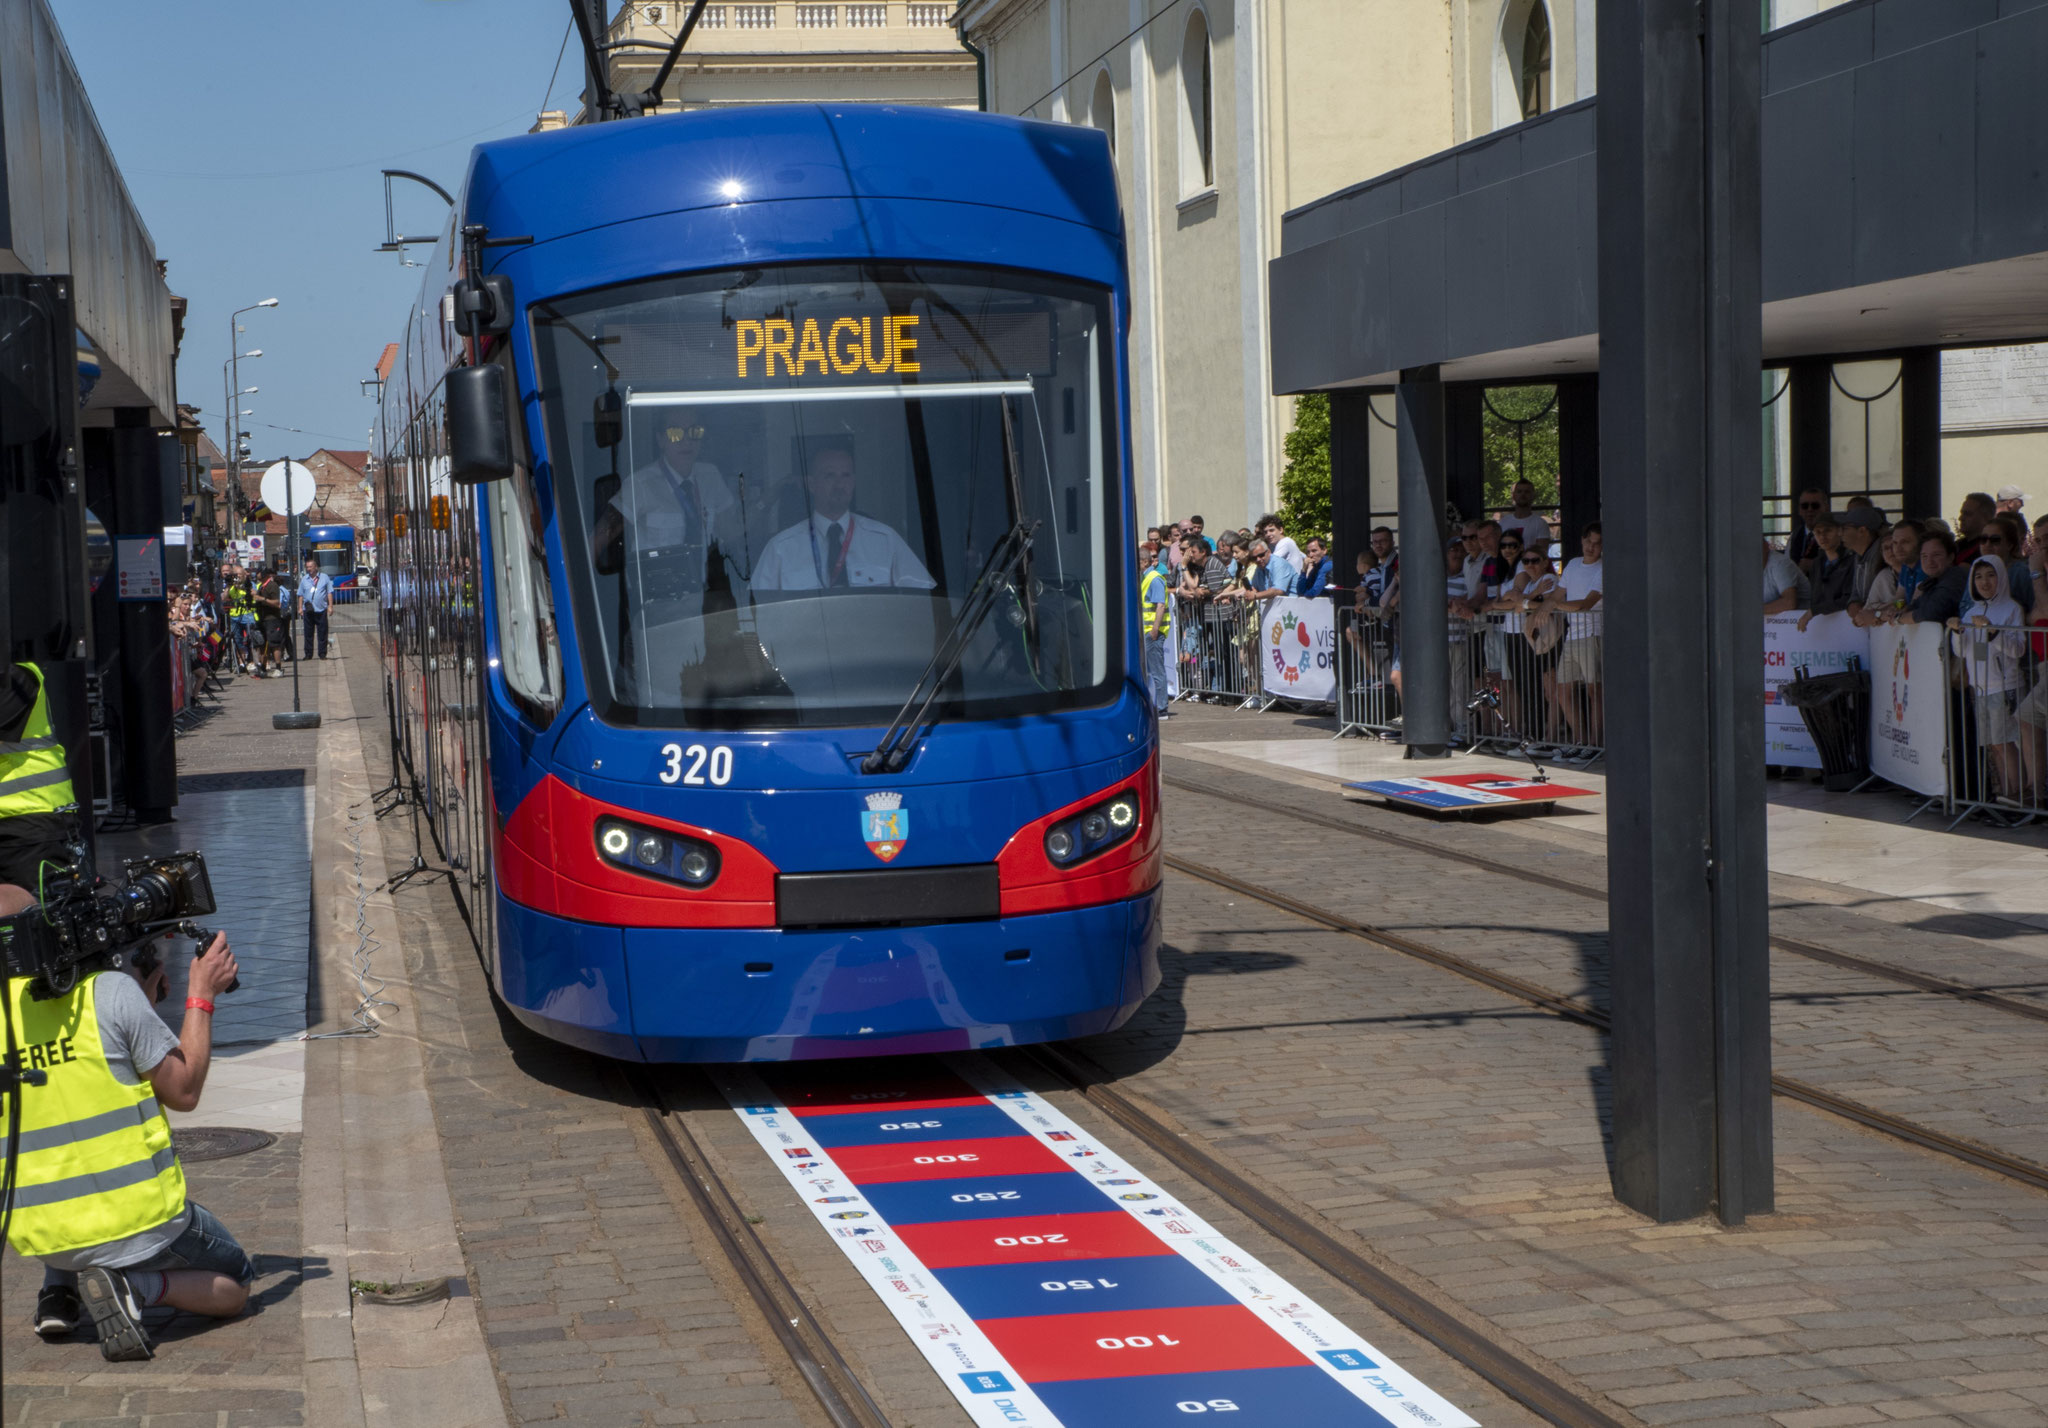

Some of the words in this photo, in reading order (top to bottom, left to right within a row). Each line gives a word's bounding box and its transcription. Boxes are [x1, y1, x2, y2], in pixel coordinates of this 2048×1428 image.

[737, 316, 920, 377] PRAGUE
[659, 743, 733, 786] 320
[880, 1120, 942, 1130] 350
[913, 1153, 979, 1164] 300
[951, 1191, 1021, 1203] 250
[994, 1233, 1069, 1247] 200
[1040, 1278, 1118, 1291] 150
[1096, 1334, 1180, 1350] 100
[1362, 1375, 1405, 1397] DIGI
[993, 1398, 1026, 1421] DIGI
[1176, 1399, 1240, 1413] 50
